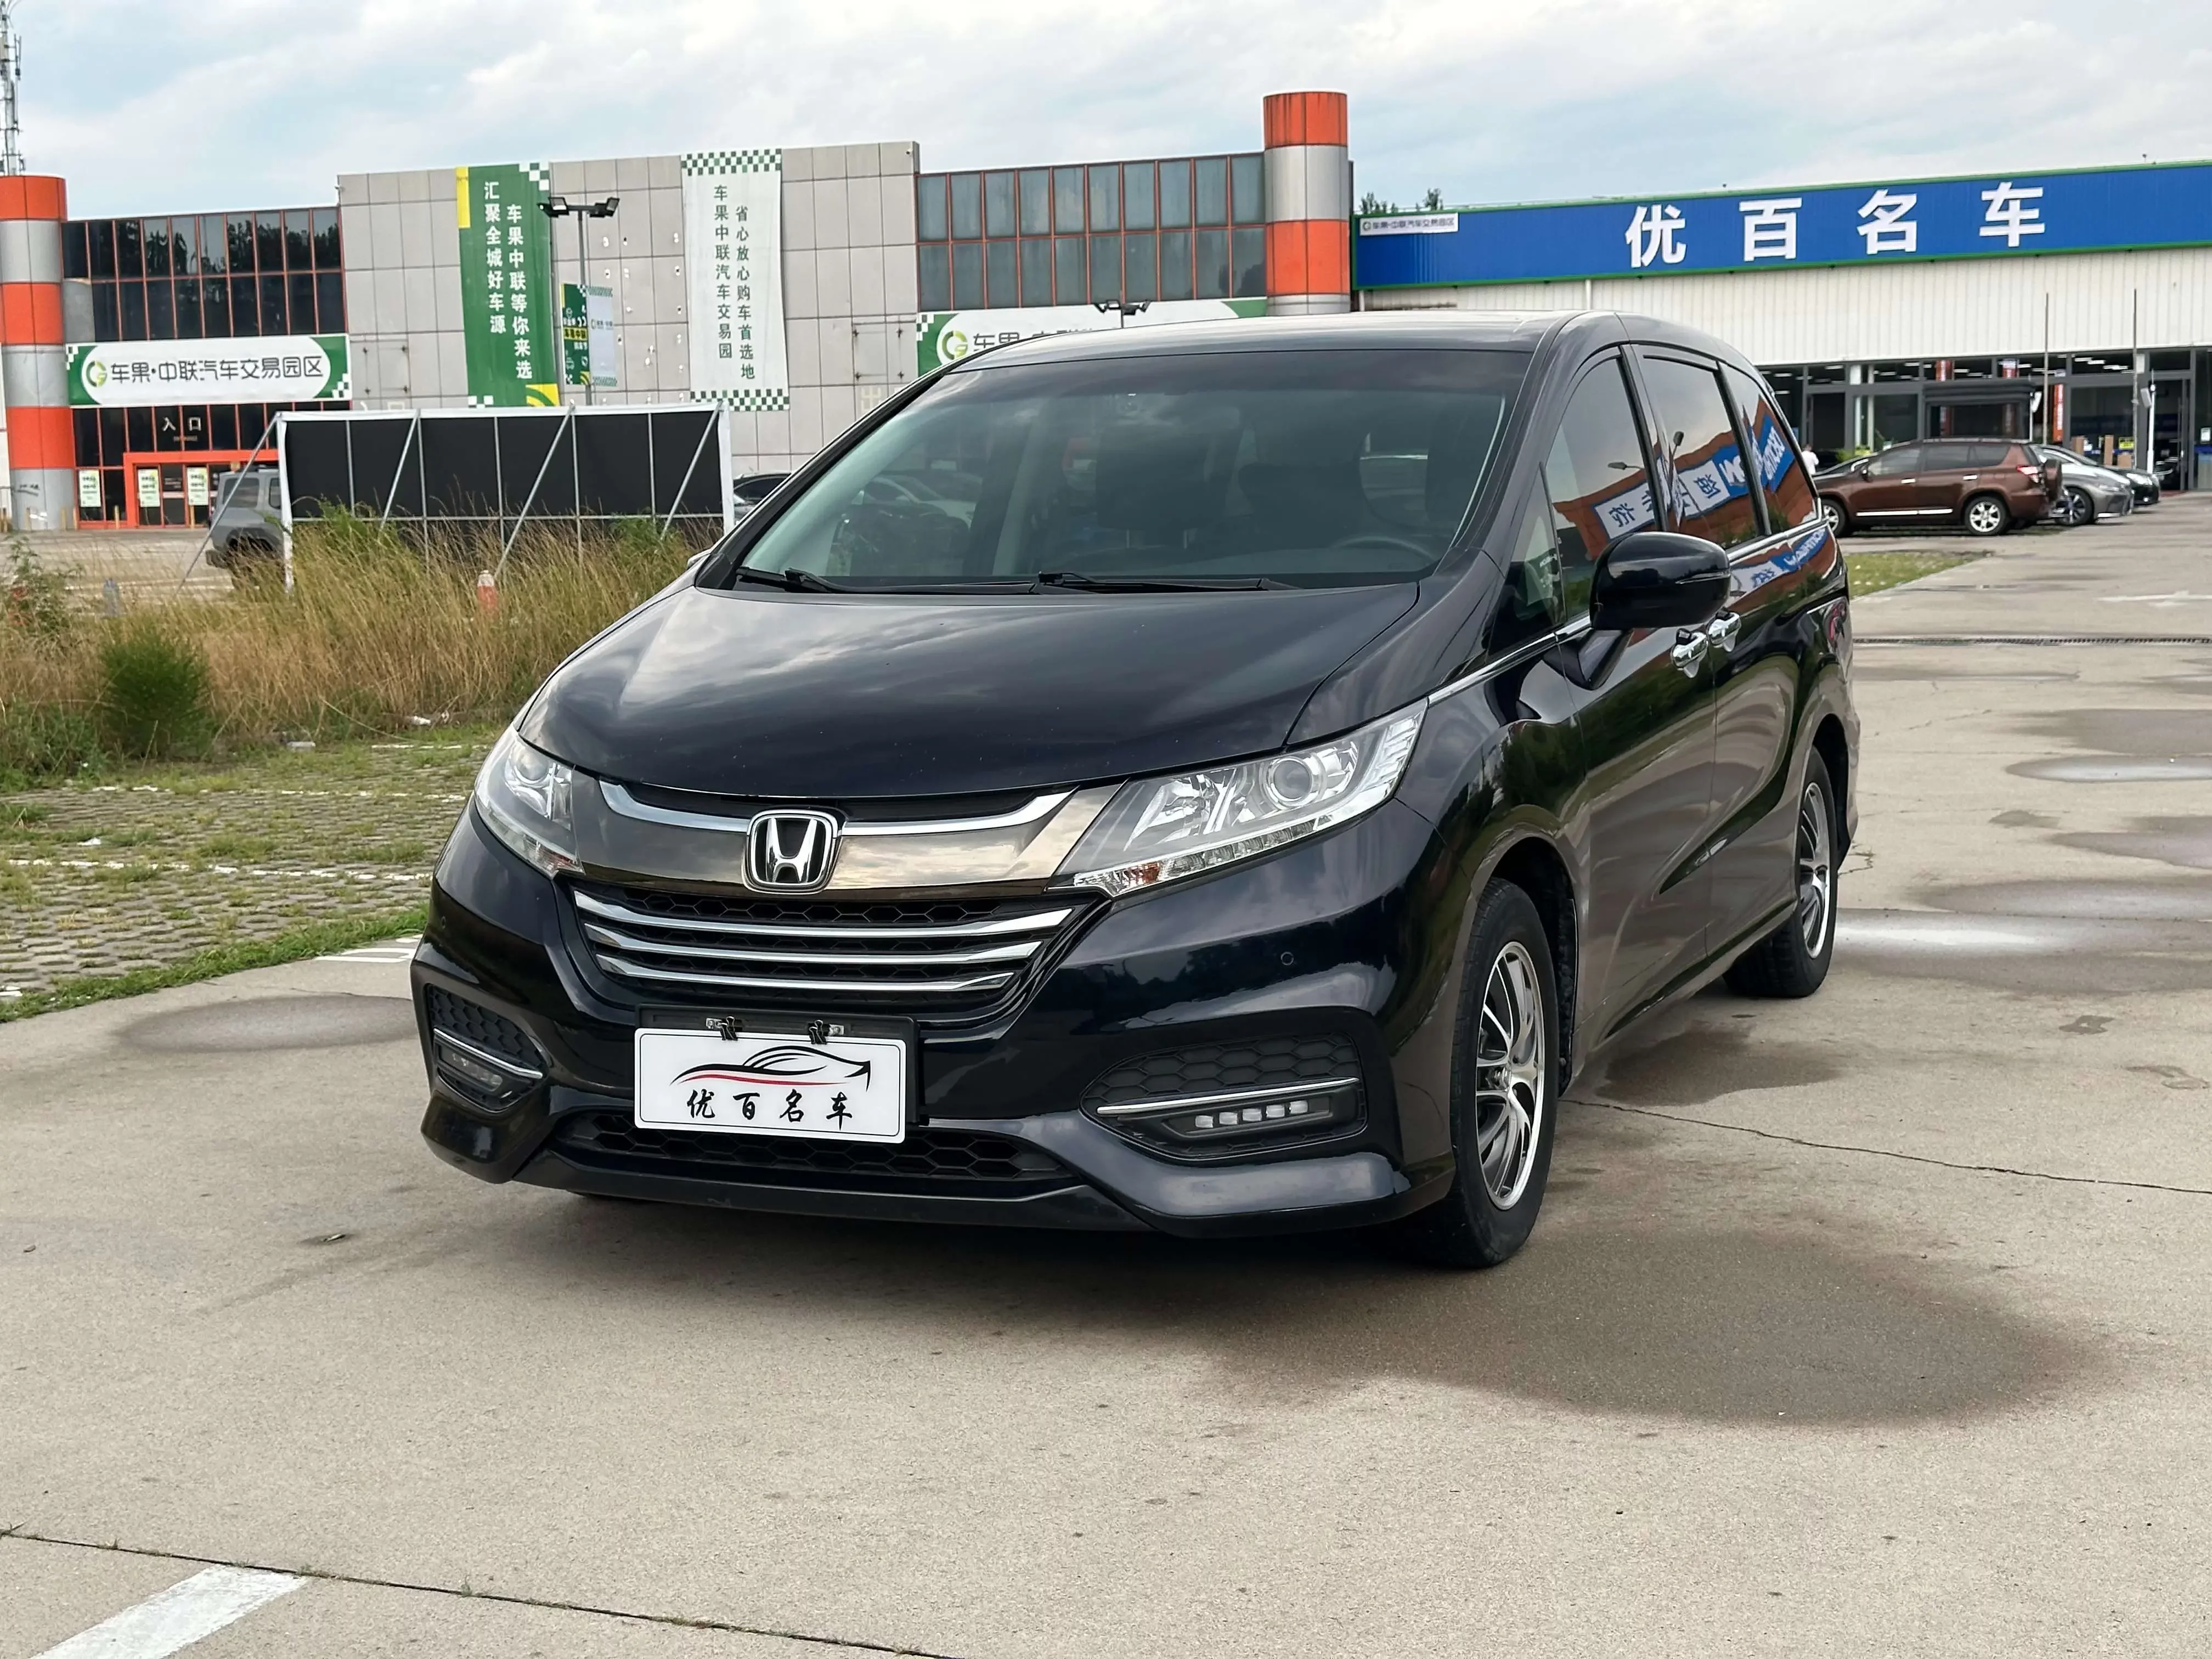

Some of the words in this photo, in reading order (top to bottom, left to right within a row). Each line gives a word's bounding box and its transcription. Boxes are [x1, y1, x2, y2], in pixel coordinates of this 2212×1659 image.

[484, 181, 506, 334] 汇聚全城好车源
[506, 204, 533, 379] 车果中联等你来选
[714, 184, 733, 359] 车果中联汽车交易园
[736, 205, 755, 380] 省心放心购车首选地
[1624, 181, 2046, 268] 优百名车
[162, 416, 202, 431] 入口
[686, 1088, 853, 1131] 优百名车
